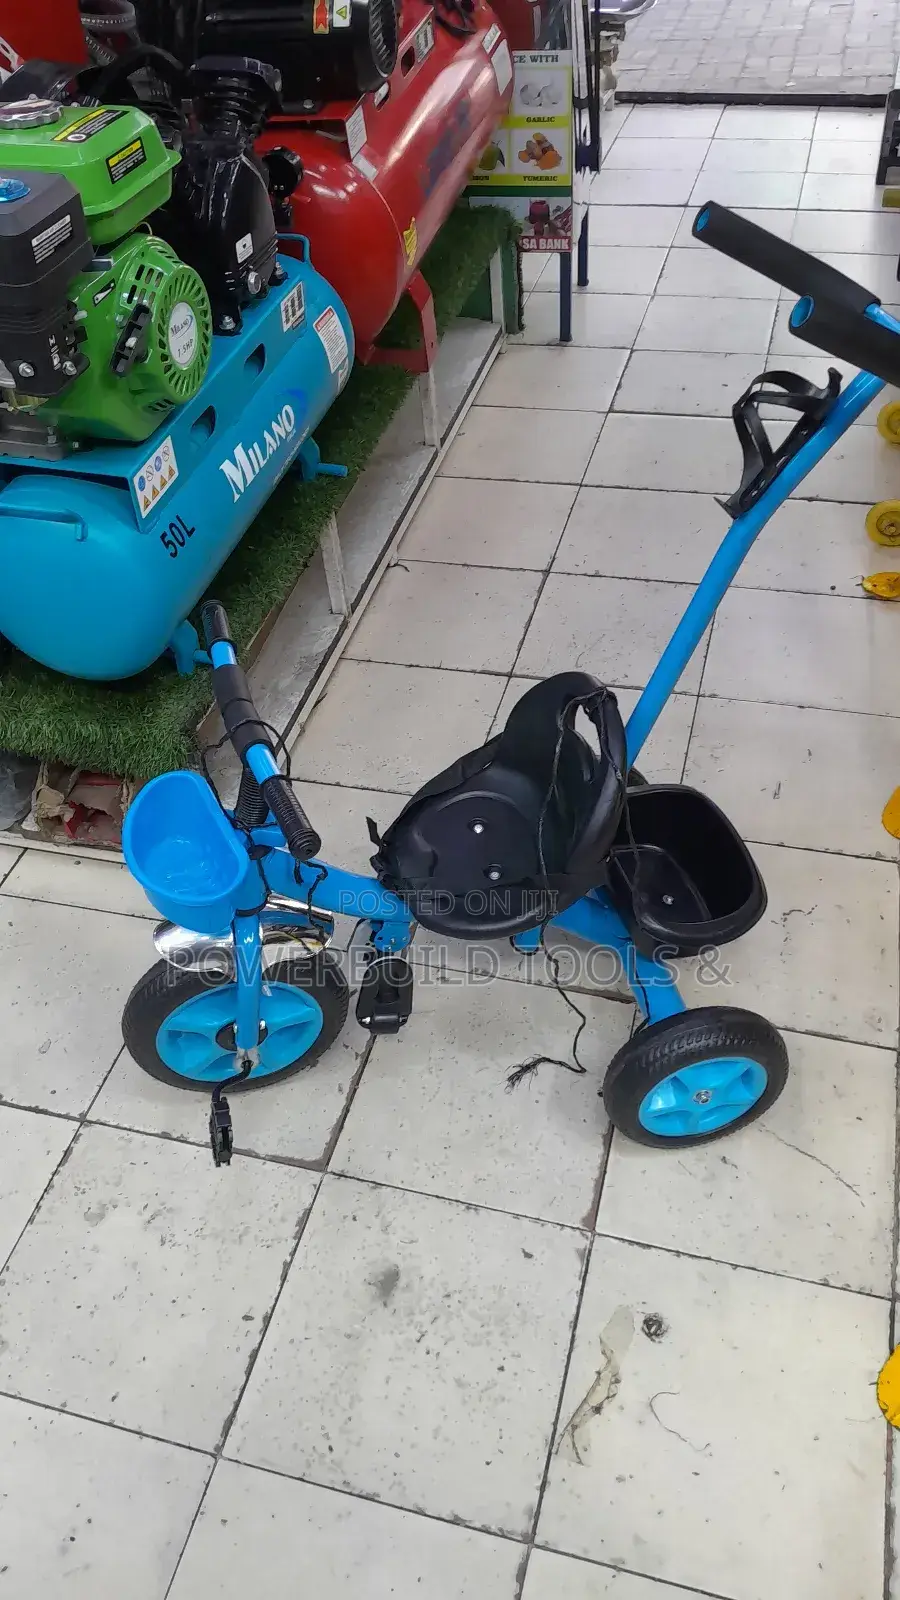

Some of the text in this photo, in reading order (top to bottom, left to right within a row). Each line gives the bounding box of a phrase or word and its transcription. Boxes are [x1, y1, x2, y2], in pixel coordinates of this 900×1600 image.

[513, 54, 559, 63] CE WITH
[522, 238, 569, 250] SA BANK
[219, 404, 295, 503] MILANO
[160, 515, 196, 558] 50L
